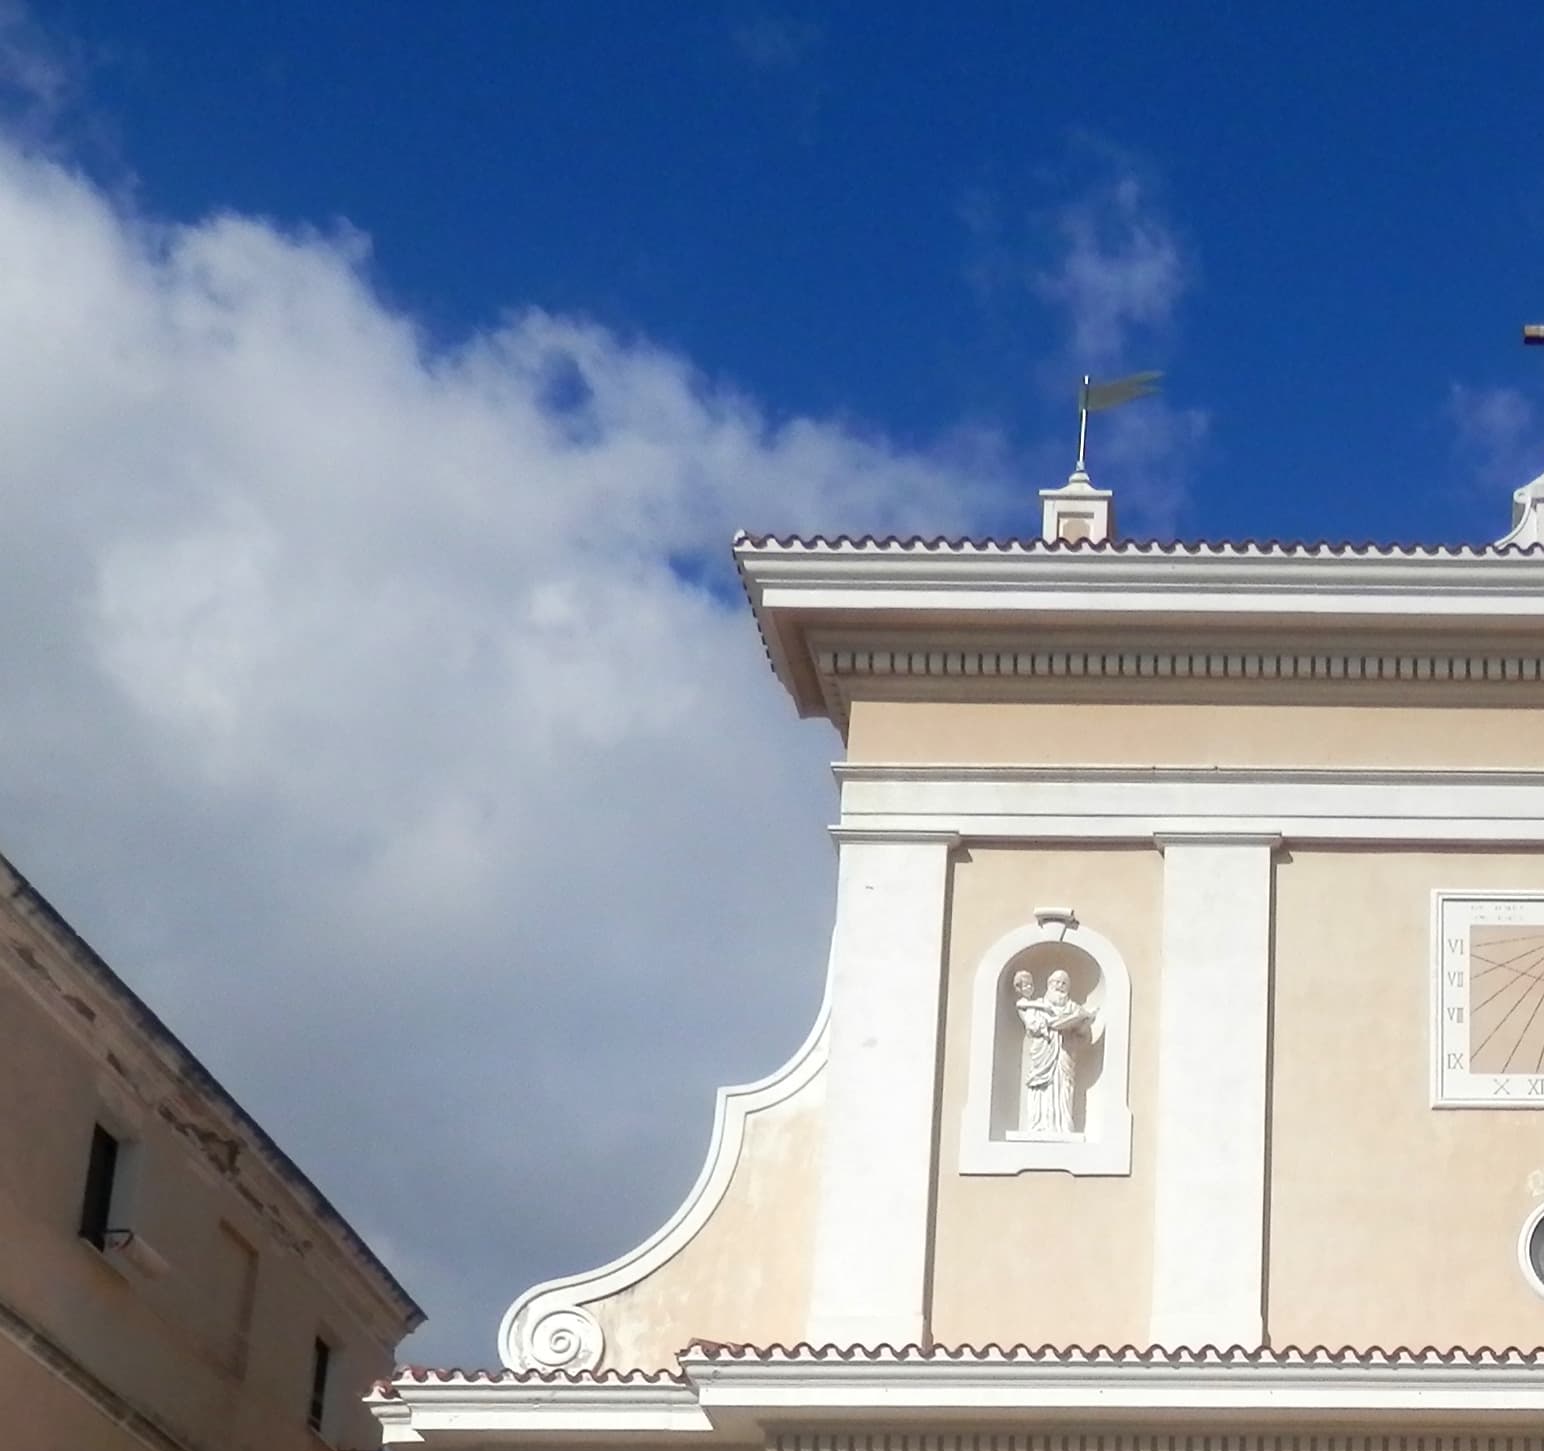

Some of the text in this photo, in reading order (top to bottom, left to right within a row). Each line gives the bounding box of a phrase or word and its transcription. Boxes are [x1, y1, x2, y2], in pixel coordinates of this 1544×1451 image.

[1448, 939, 1464, 955] VI
[1448, 971, 1464, 988] VII
[1448, 1053, 1464, 1070] IX
[1493, 1078, 1510, 1095] X
[1528, 1078, 1544, 1095] XI
